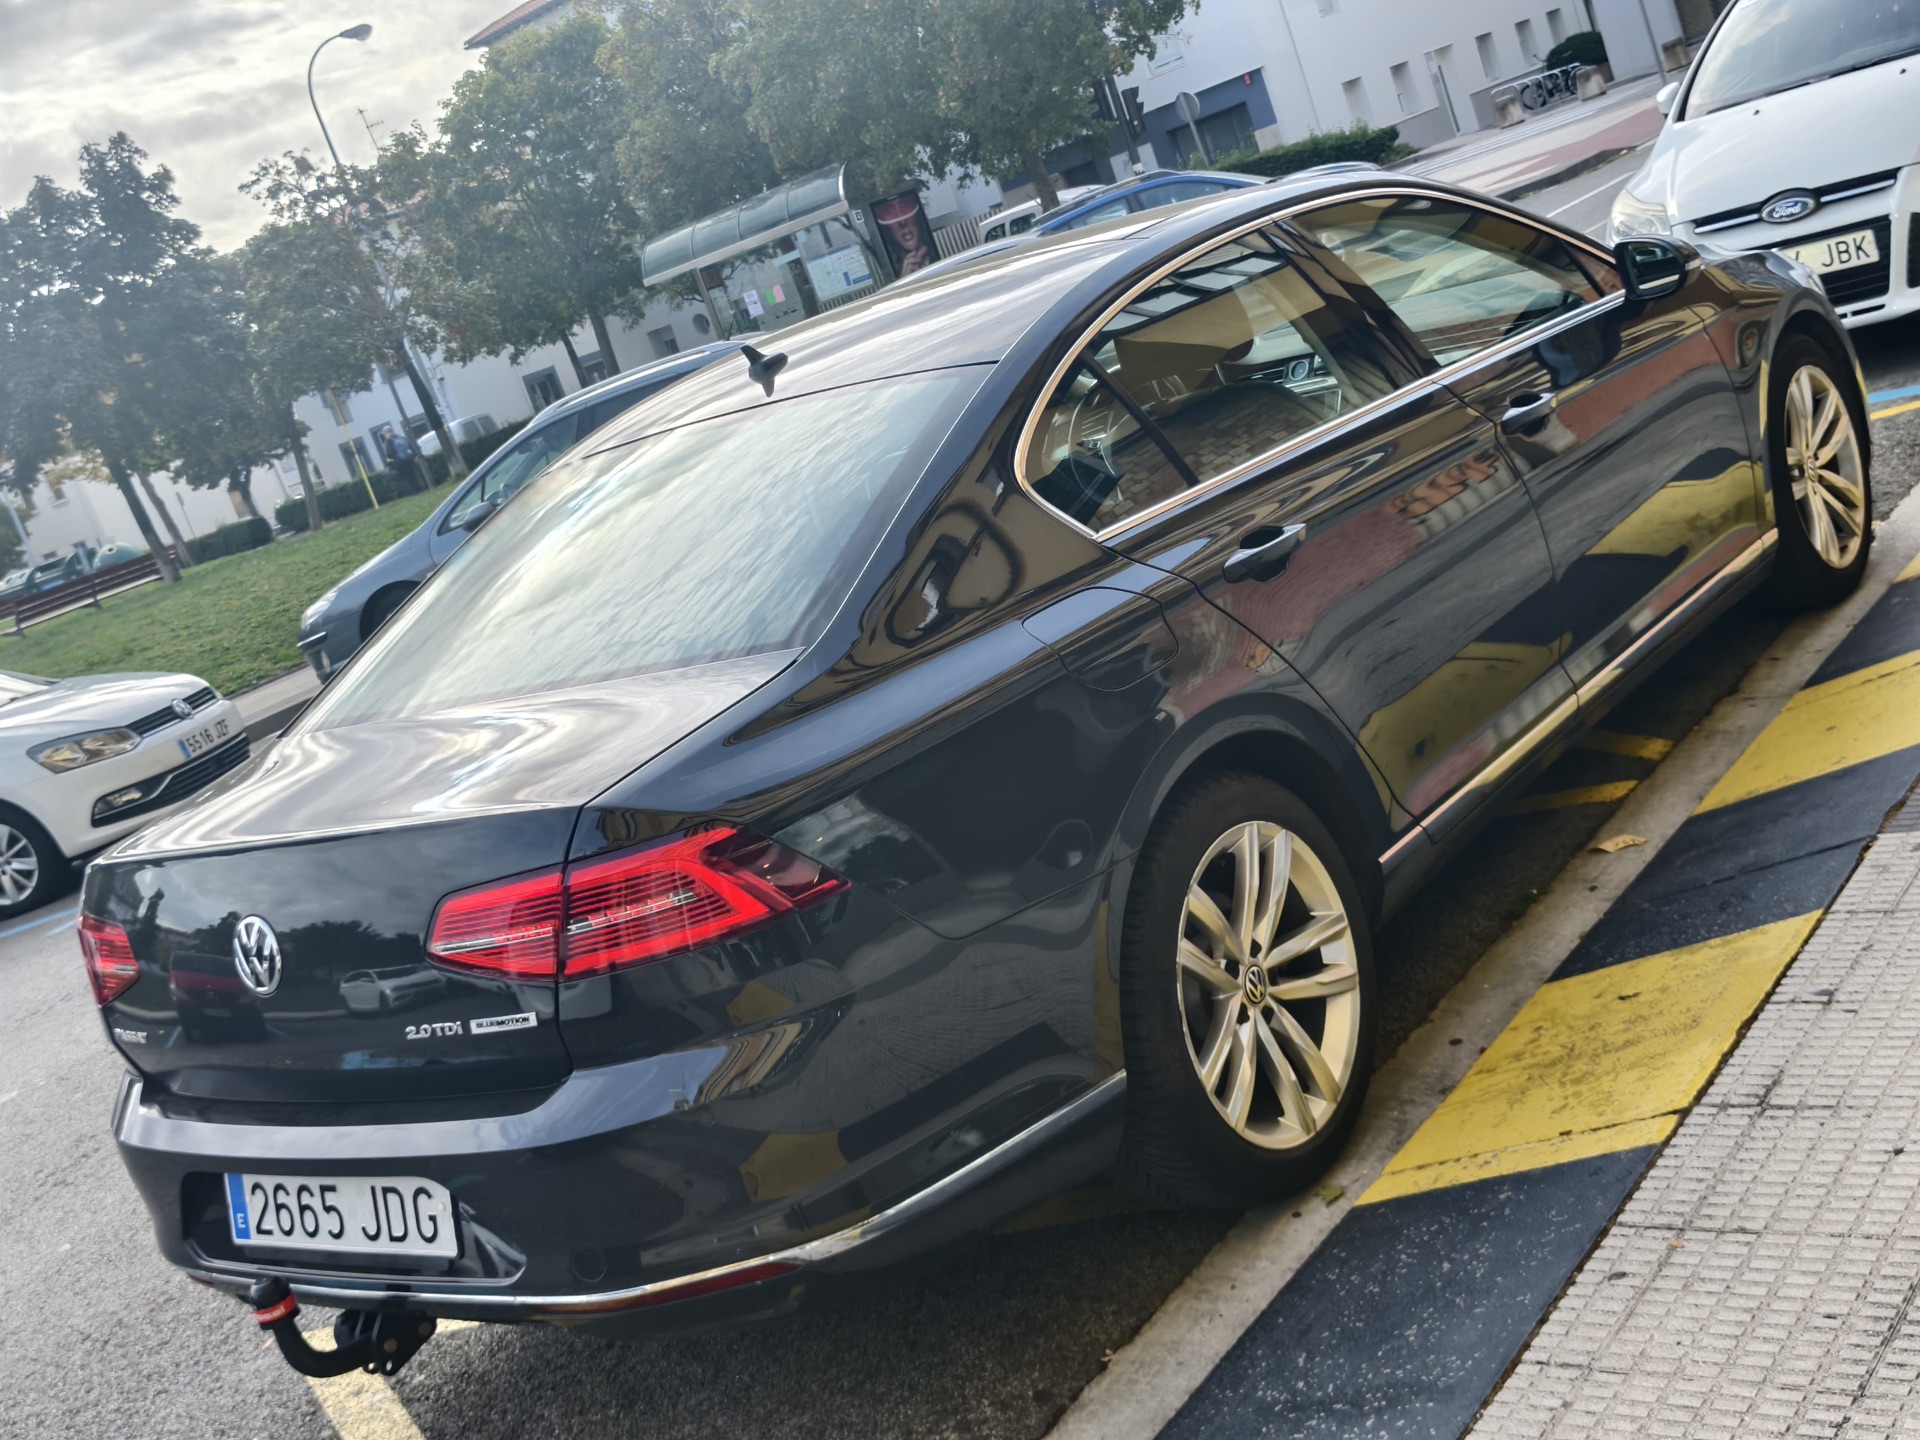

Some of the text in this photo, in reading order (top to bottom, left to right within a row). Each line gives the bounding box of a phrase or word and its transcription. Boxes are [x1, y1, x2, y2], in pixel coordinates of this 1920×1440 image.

[1772, 201, 1802, 218] Ford
[1822, 235, 1870, 267] JBK
[186, 728, 215, 753] 5516
[236, 1181, 439, 1244] E 2665 JDG
